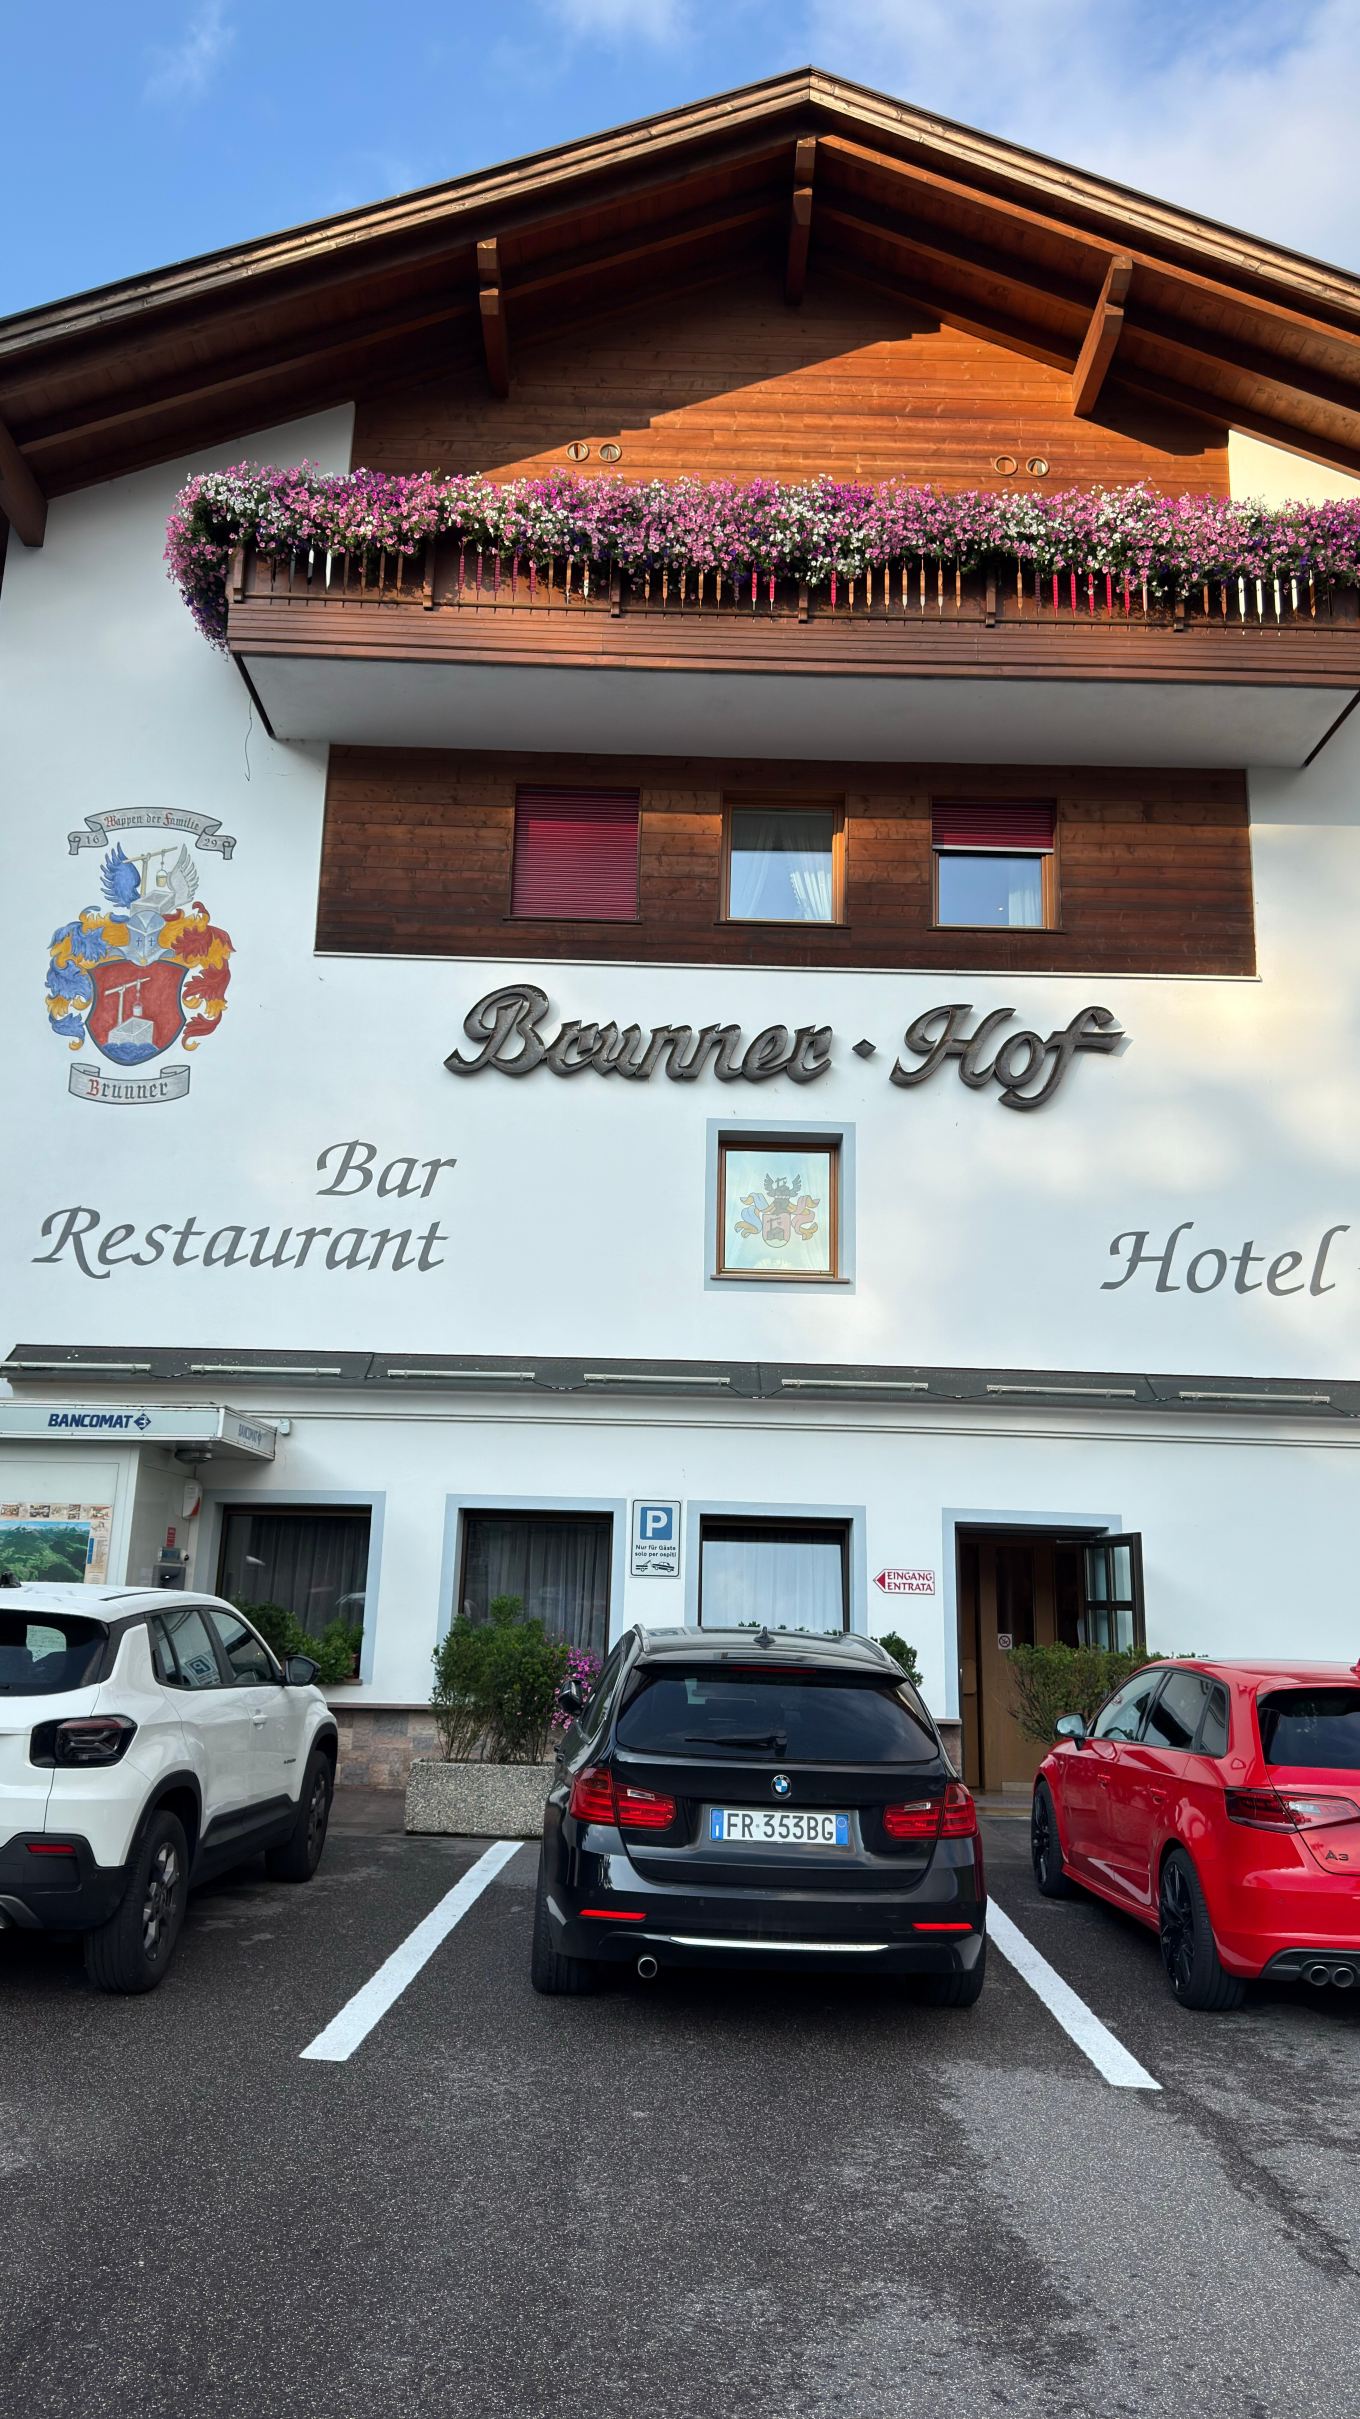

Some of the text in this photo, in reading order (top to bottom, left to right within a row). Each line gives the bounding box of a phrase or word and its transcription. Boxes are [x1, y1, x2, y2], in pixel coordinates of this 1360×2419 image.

[104, 812, 200, 830] Wappen der Familie
[86, 835, 100, 845] 16
[204, 838, 218, 848] 29
[443, 983, 1124, 1109] Brunner Hof
[86, 1079, 168, 1099] Brunner
[315, 1139, 457, 1199] Bar
[31, 1205, 450, 1280] Restaurant
[1099, 1221, 1351, 1297] Hotel
[48, 1413, 133, 1428] BANCOMAT
[646, 1510, 668, 1537] P
[887, 1571, 932, 1581] EINGANG
[887, 1582, 932, 1592] ENTRATA
[1325, 1850, 1349, 1861] A3
